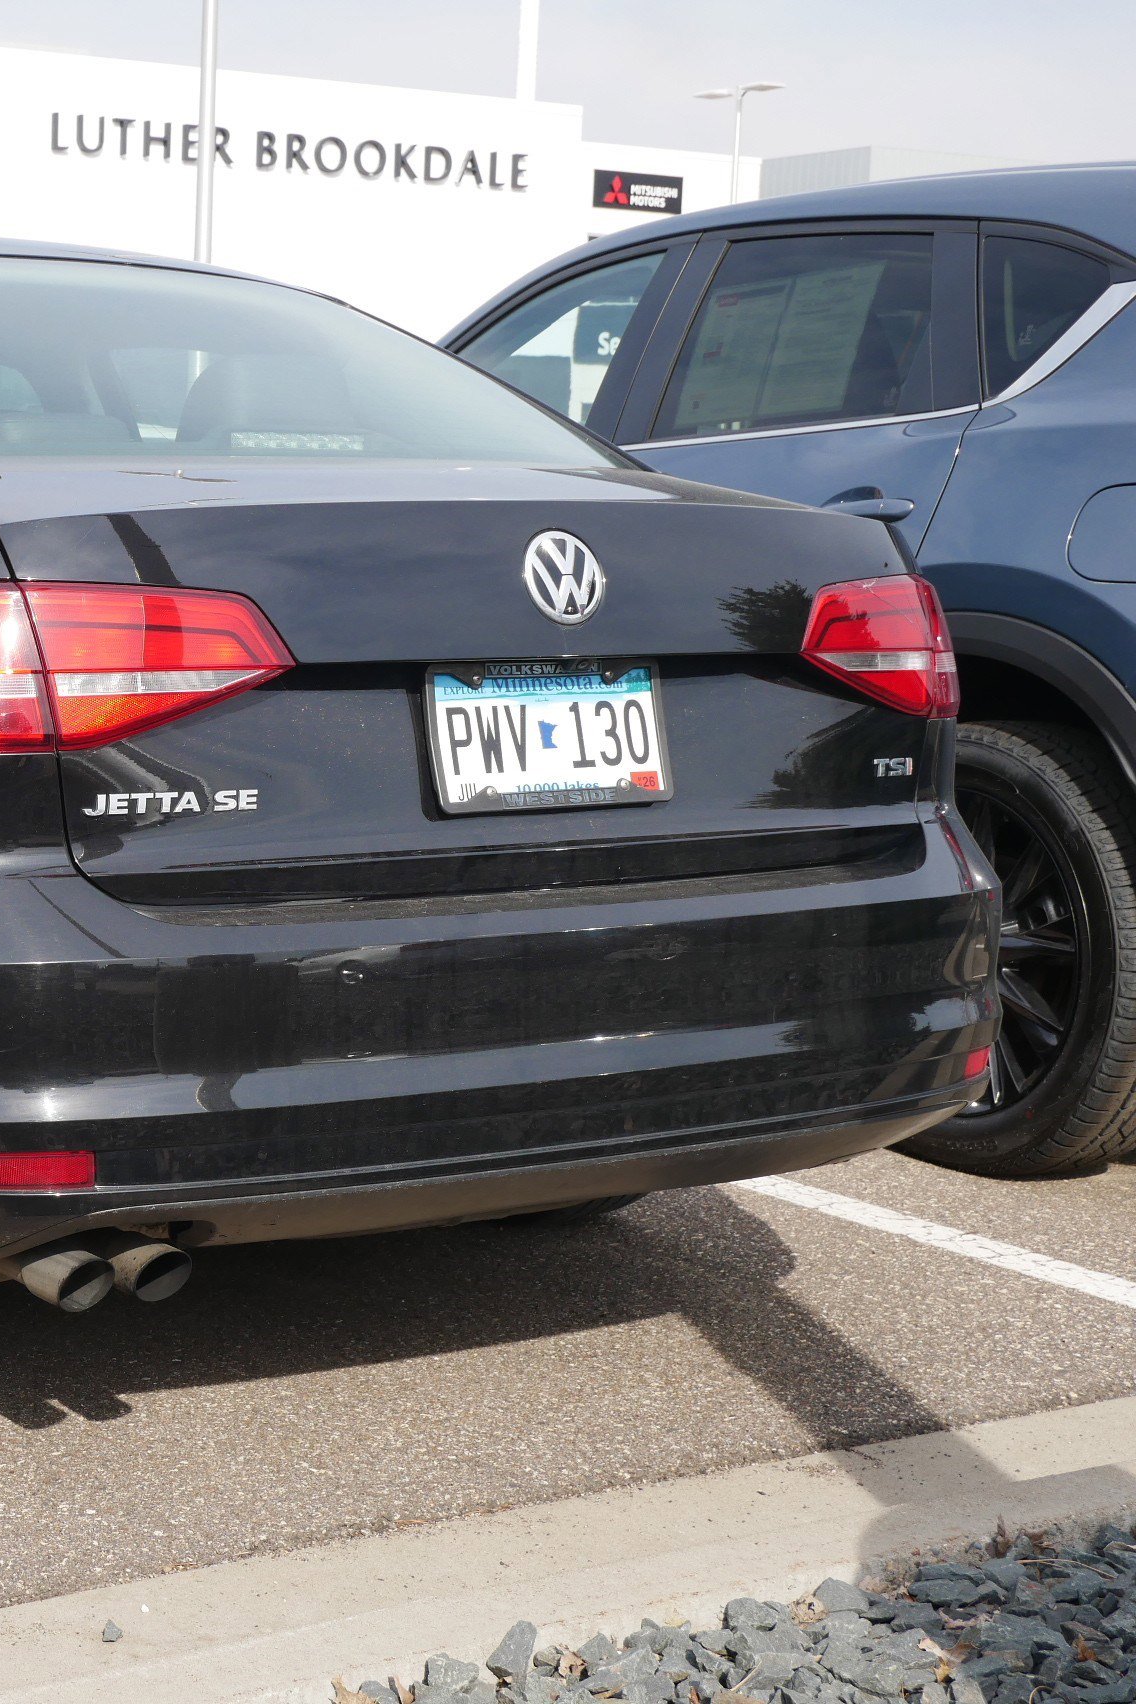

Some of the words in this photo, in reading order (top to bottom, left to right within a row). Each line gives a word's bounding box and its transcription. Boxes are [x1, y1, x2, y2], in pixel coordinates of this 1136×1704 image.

[51, 113, 233, 165] LUTHER
[256, 131, 529, 188] BROOKDALE
[630, 184, 678, 198] MITSUBISHI
[630, 195, 666, 208] MOTORS
[597, 332, 621, 356] Se
[489, 664, 599, 675] VOLKSWAN
[446, 704, 527, 775] PWV
[569, 699, 651, 769] 130
[873, 757, 913, 777] TSI
[516, 782, 559, 793] 10000
[642, 775, 656, 787] 26
[82, 791, 201, 816] JETTA
[213, 789, 259, 811] SE
